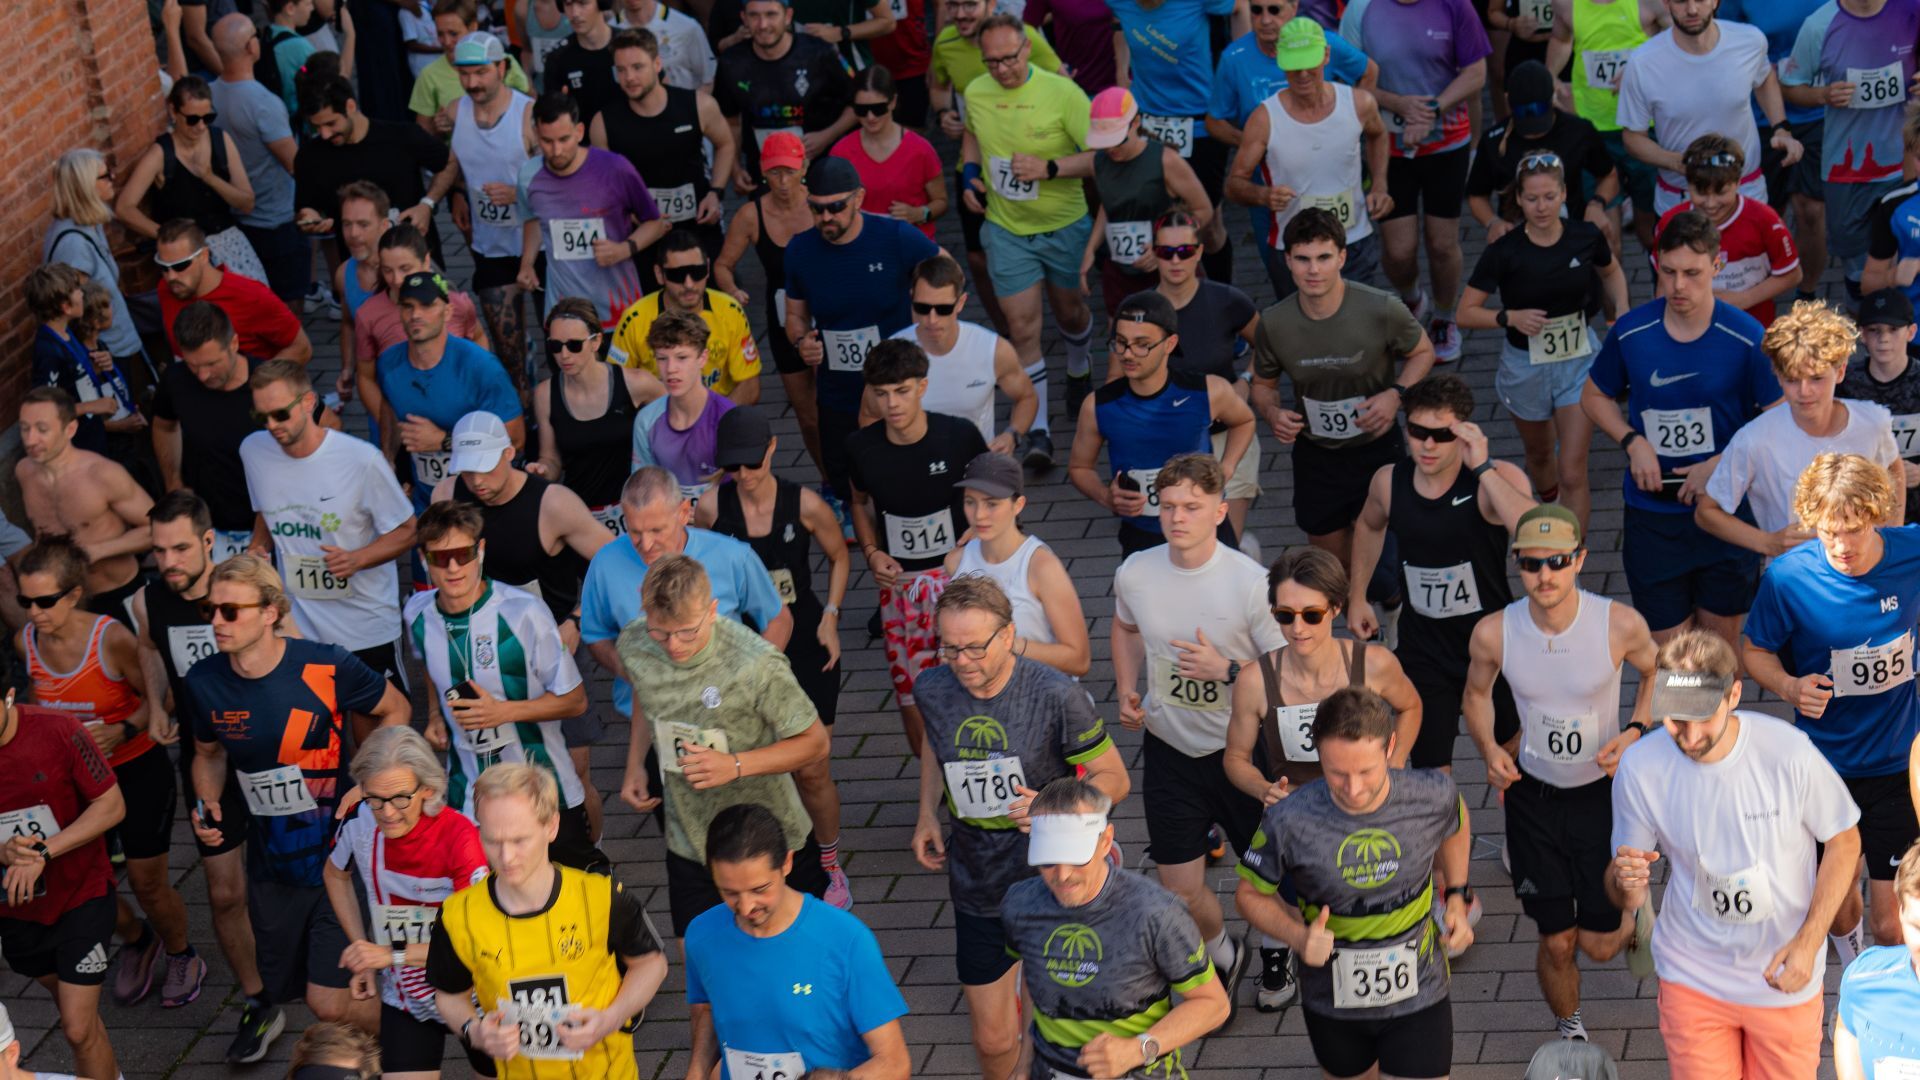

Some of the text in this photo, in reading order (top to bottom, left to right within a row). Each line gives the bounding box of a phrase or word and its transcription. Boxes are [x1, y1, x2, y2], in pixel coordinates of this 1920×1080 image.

[1597, 60, 1627, 82] 47
[1860, 76, 1899, 102] 368
[999, 170, 1033, 192] 749
[478, 200, 511, 220] 292
[1113, 235, 1146, 256] 225
[1543, 326, 1580, 355] 317
[1658, 422, 1705, 448] 283
[272, 521, 322, 540] JOHN
[901, 523, 947, 551] 914
[295, 568, 348, 590] 1169
[1420, 579, 1470, 608] 774
[1880, 596, 1899, 614] MS
[1852, 649, 1905, 686] 985
[1170, 674, 1217, 703] 208
[211, 710, 250, 724] LSP
[1548, 731, 1582, 755] 60
[250, 778, 304, 805] 1777
[961, 773, 1023, 803] 1780
[1712, 890, 1752, 915] 96
[1352, 962, 1409, 997] 356
